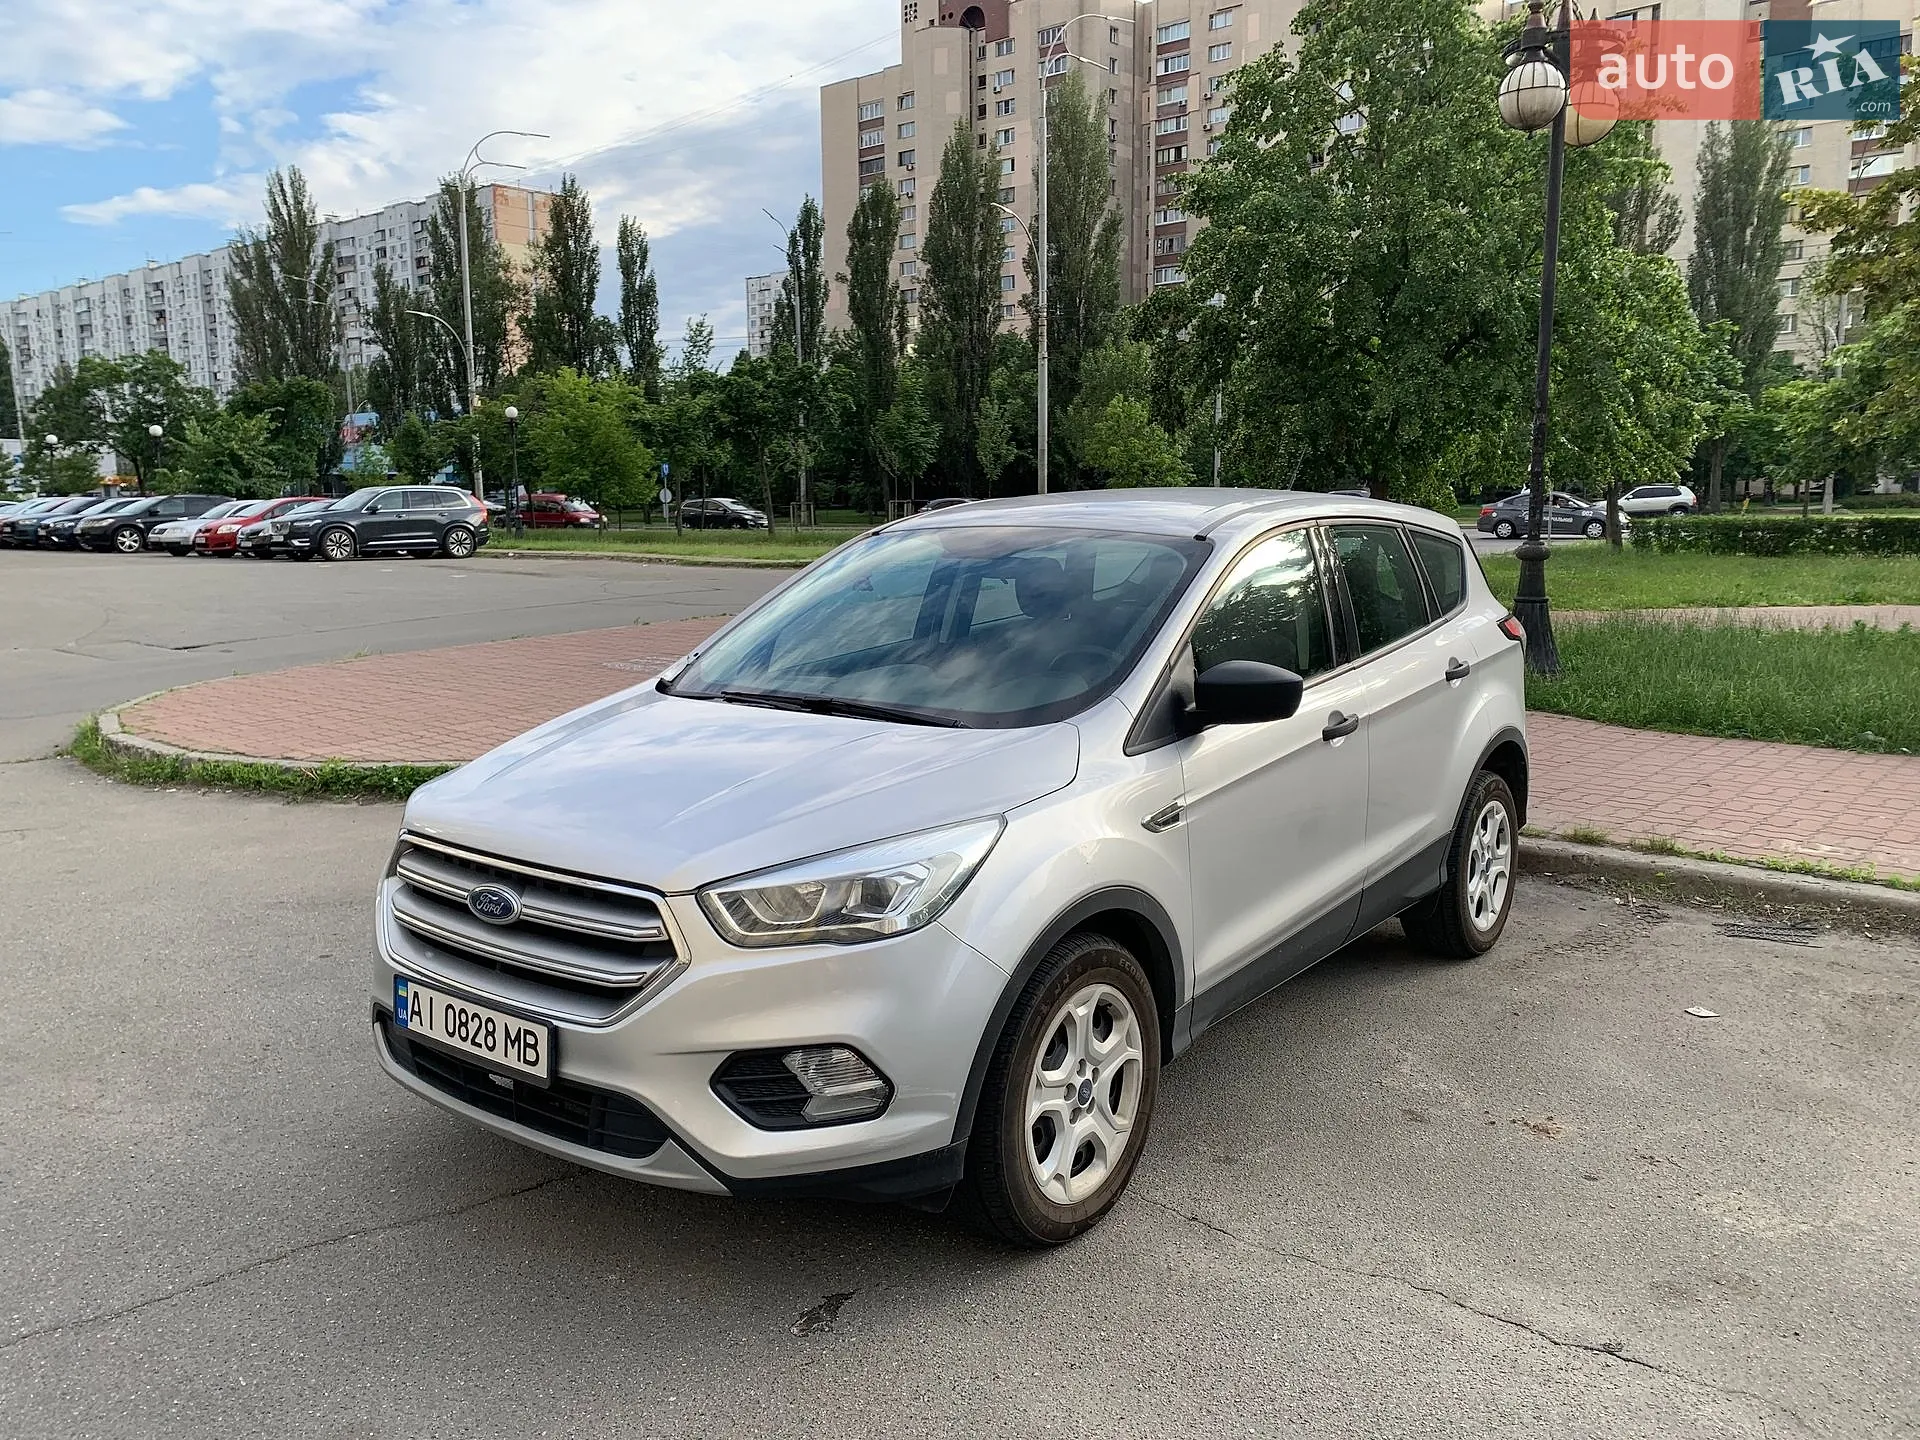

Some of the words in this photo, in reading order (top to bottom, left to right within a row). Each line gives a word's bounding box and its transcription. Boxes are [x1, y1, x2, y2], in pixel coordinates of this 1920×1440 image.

[476, 892, 505, 915] Ford
[398, 1007, 408, 1020] UA
[409, 990, 434, 1031] AI
[444, 1002, 497, 1052] 0828
[504, 1021, 541, 1067] MB
